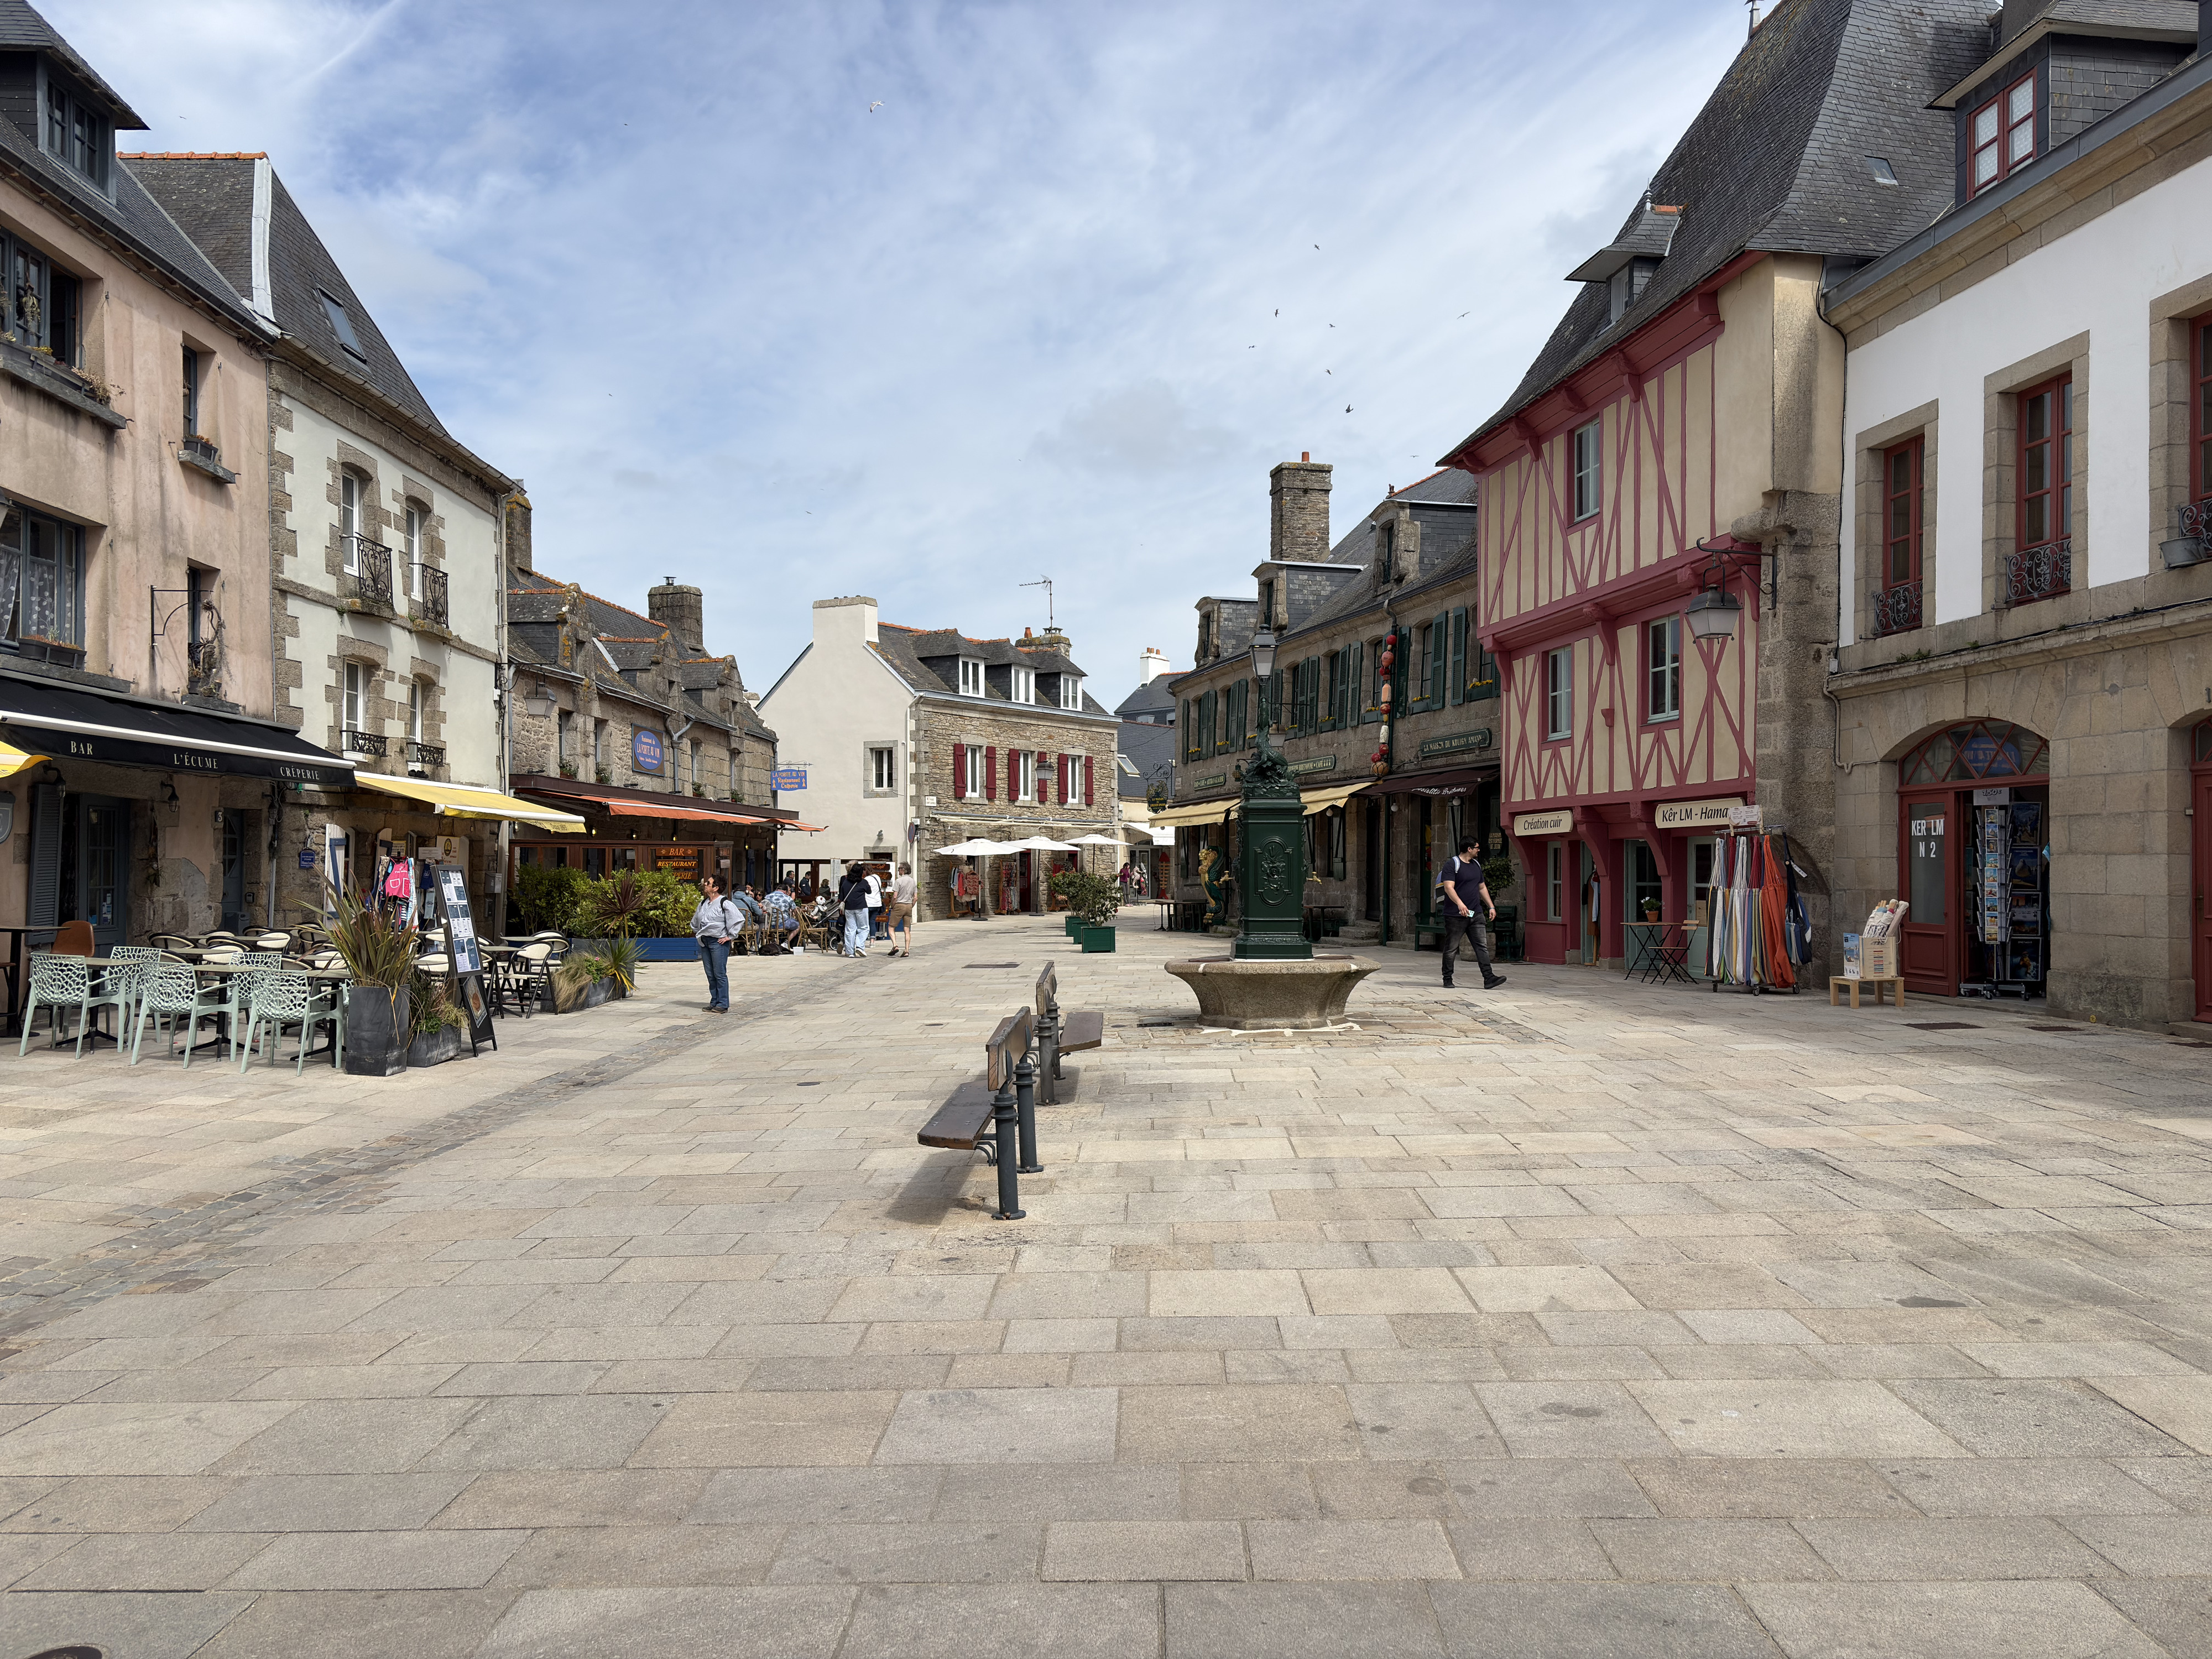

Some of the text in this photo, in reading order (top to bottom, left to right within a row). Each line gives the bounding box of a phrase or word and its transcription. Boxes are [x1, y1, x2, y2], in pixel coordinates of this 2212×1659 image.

[71, 740, 93, 755] BAR
[637, 743, 641, 753] LA
[641, 744, 650, 755] PORTE
[650, 746, 654, 756] AU
[1430, 742, 1444, 750] MAISON
[1452, 738, 1467, 747] KOUIGN
[1468, 734, 1482, 744] AMANN
[174, 752, 218, 769] L'ÉCUME
[1298, 762, 1313, 771] BRETONNE
[280, 765, 320, 780] CRÊPERIE
[218, 811, 223, 822] 3
[1662, 807, 1678, 822] Kêr
[1679, 807, 1693, 821] LM
[1699, 806, 1729, 820] Hama
[1524, 816, 1562, 831] Création cuir
[1911, 819, 1944, 836] KER LM
[669, 848, 685, 856] BAR
[1919, 842, 1936, 858] N 2
